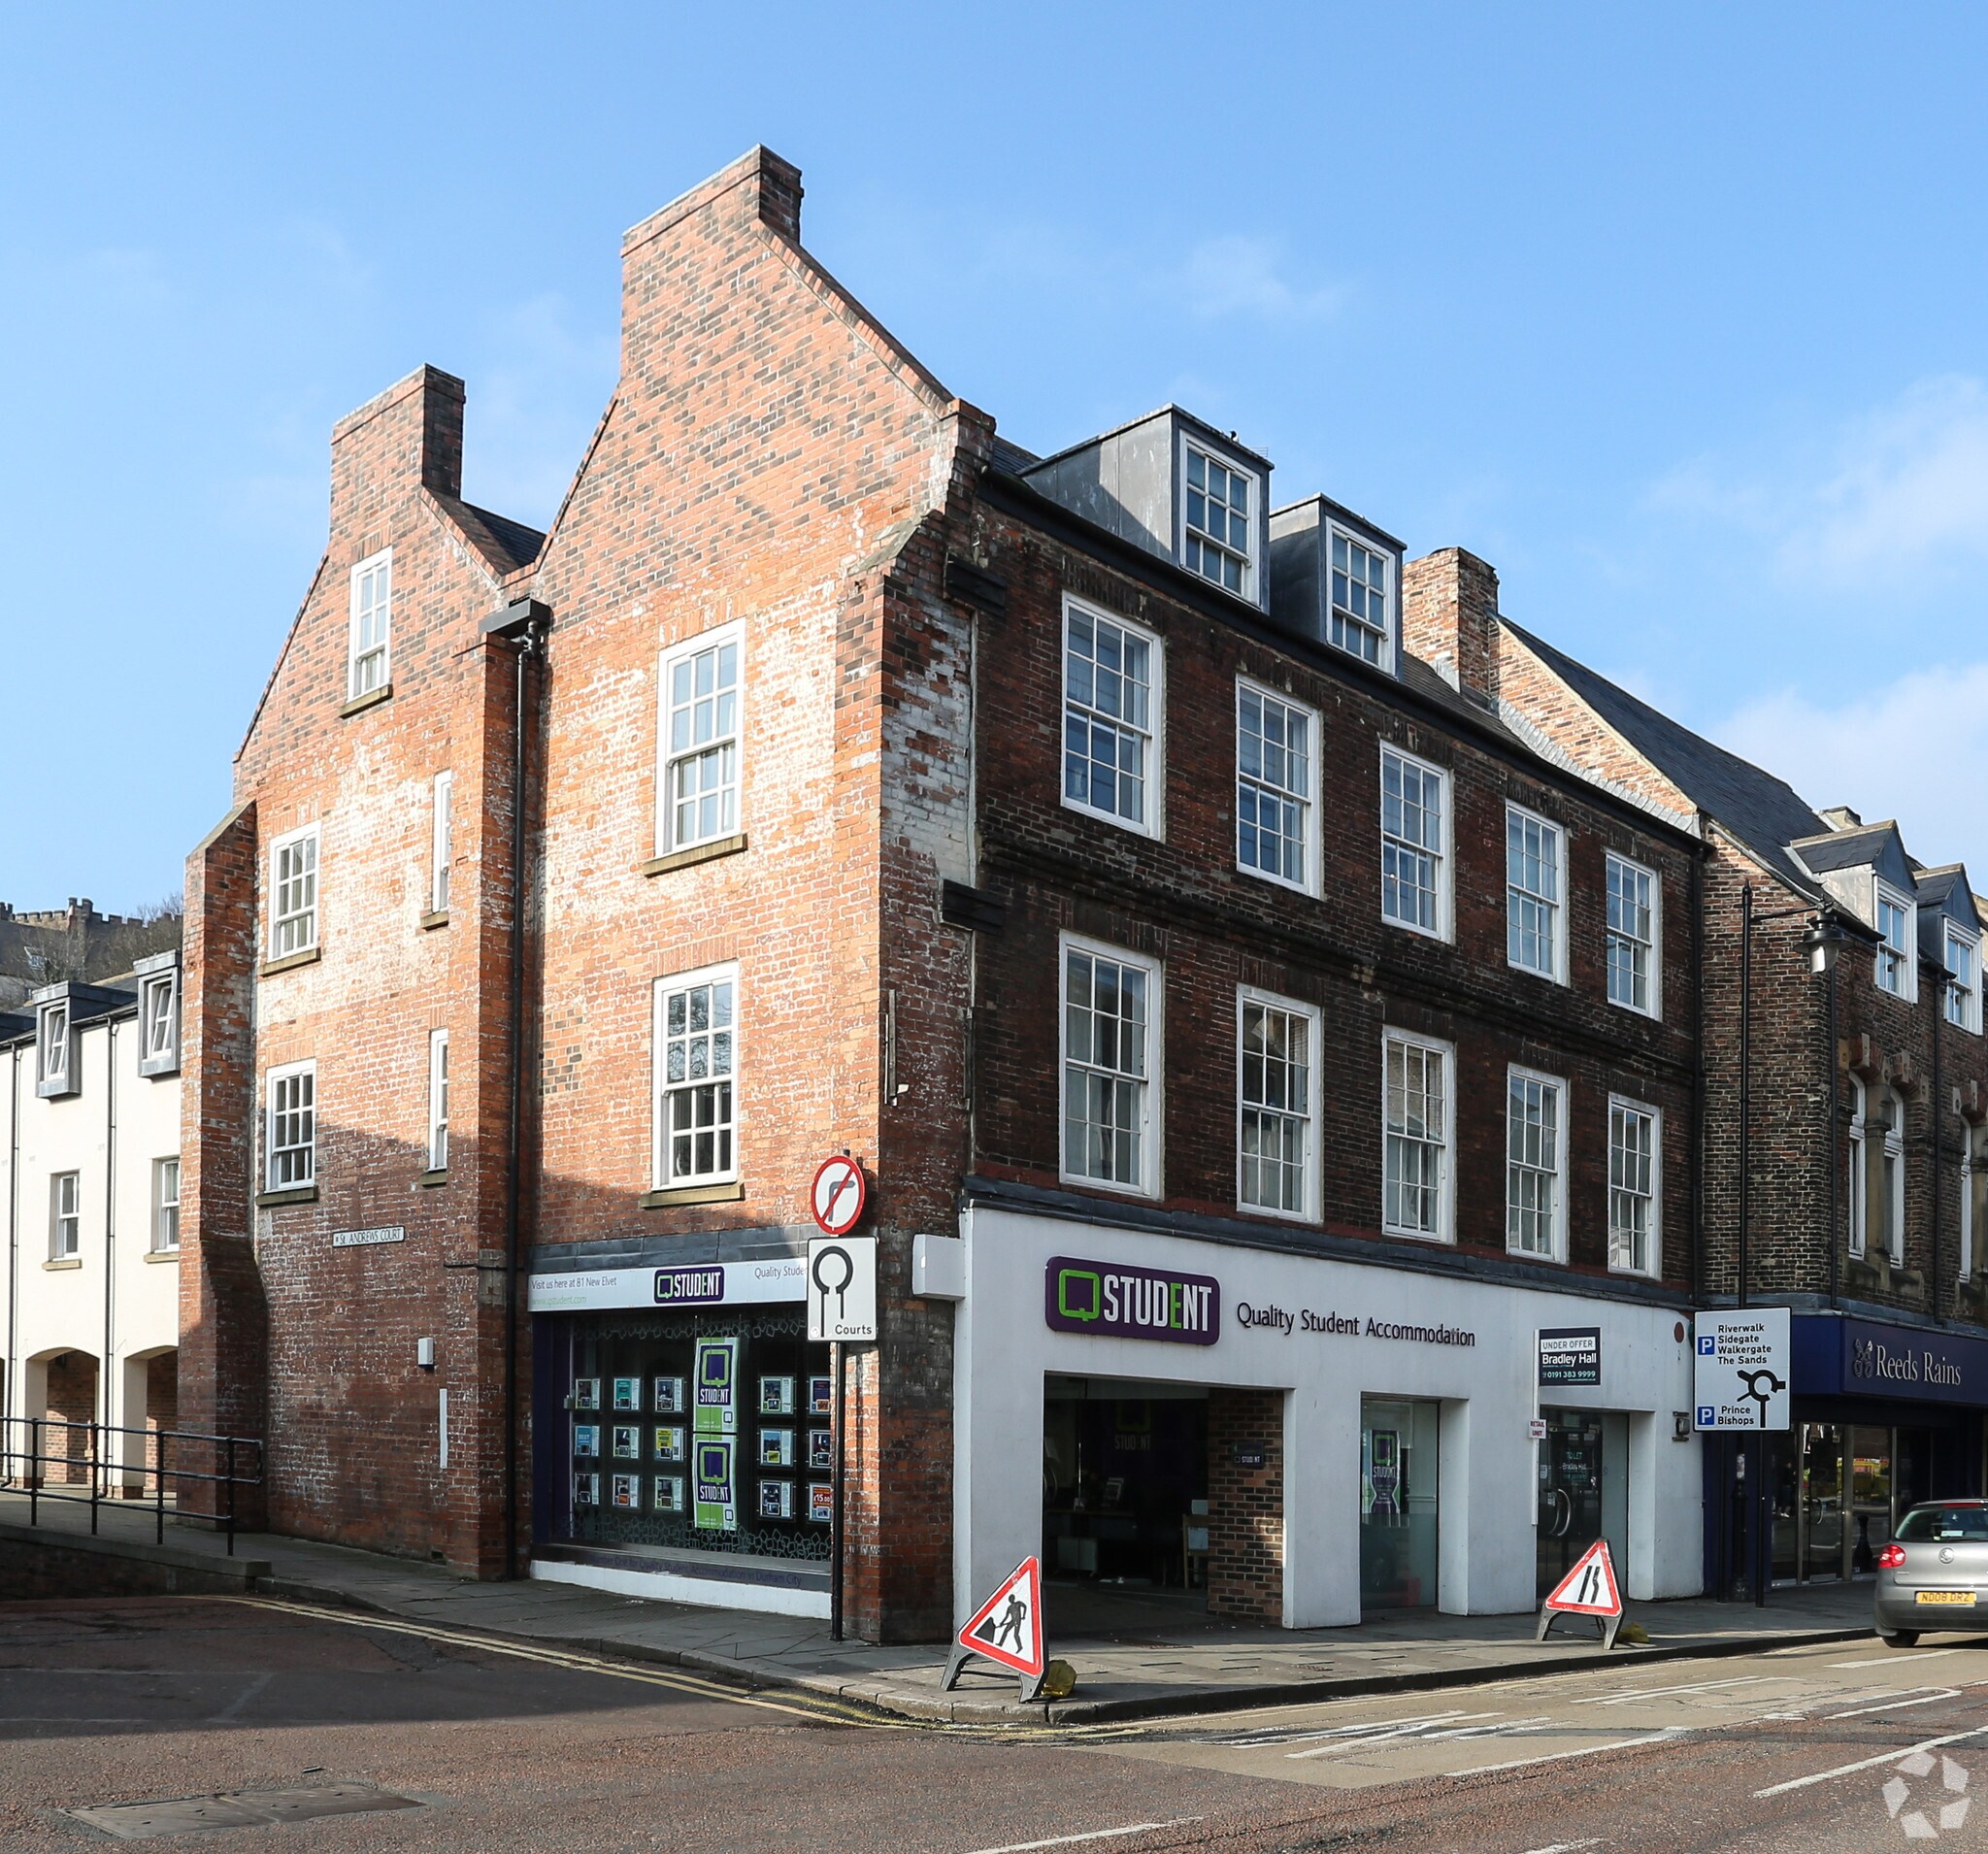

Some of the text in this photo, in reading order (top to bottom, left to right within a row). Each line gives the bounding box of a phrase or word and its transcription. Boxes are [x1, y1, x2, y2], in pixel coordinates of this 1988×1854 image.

[349, 1231, 379, 1242] ANDREWS
[381, 1228, 401, 1241] COURT
[754, 1265, 808, 1279] Quality Stude
[531, 1280, 546, 1289] Visit
[554, 1279, 568, 1288] here
[569, 1279, 576, 1288] at
[577, 1277, 584, 1287] 81
[586, 1277, 600, 1286] New
[602, 1276, 617, 1286] Elvet
[835, 1324, 872, 1335] Courts
[1237, 1302, 1475, 1347] Quality Student Accommodation
[1718, 1323, 1765, 1333] Riverwalk
[1718, 1335, 1760, 1344] Sidegate
[1717, 1344, 1772, 1354] Walkergate
[1542, 1353, 1597, 1367] Bradley Hall
[1738, 1356, 1767, 1365] Sands
[1876, 1344, 1961, 1385] Reeds Rains
[700, 1388, 729, 1403] STUDENT
[1721, 1406, 1750, 1414] Prince
[1717, 1416, 1754, 1426] Bishops
[1374, 1467, 1396, 1477] STUDENT
[700, 1485, 728, 1501] STUDENT
[787, 1573, 802, 1587] City
